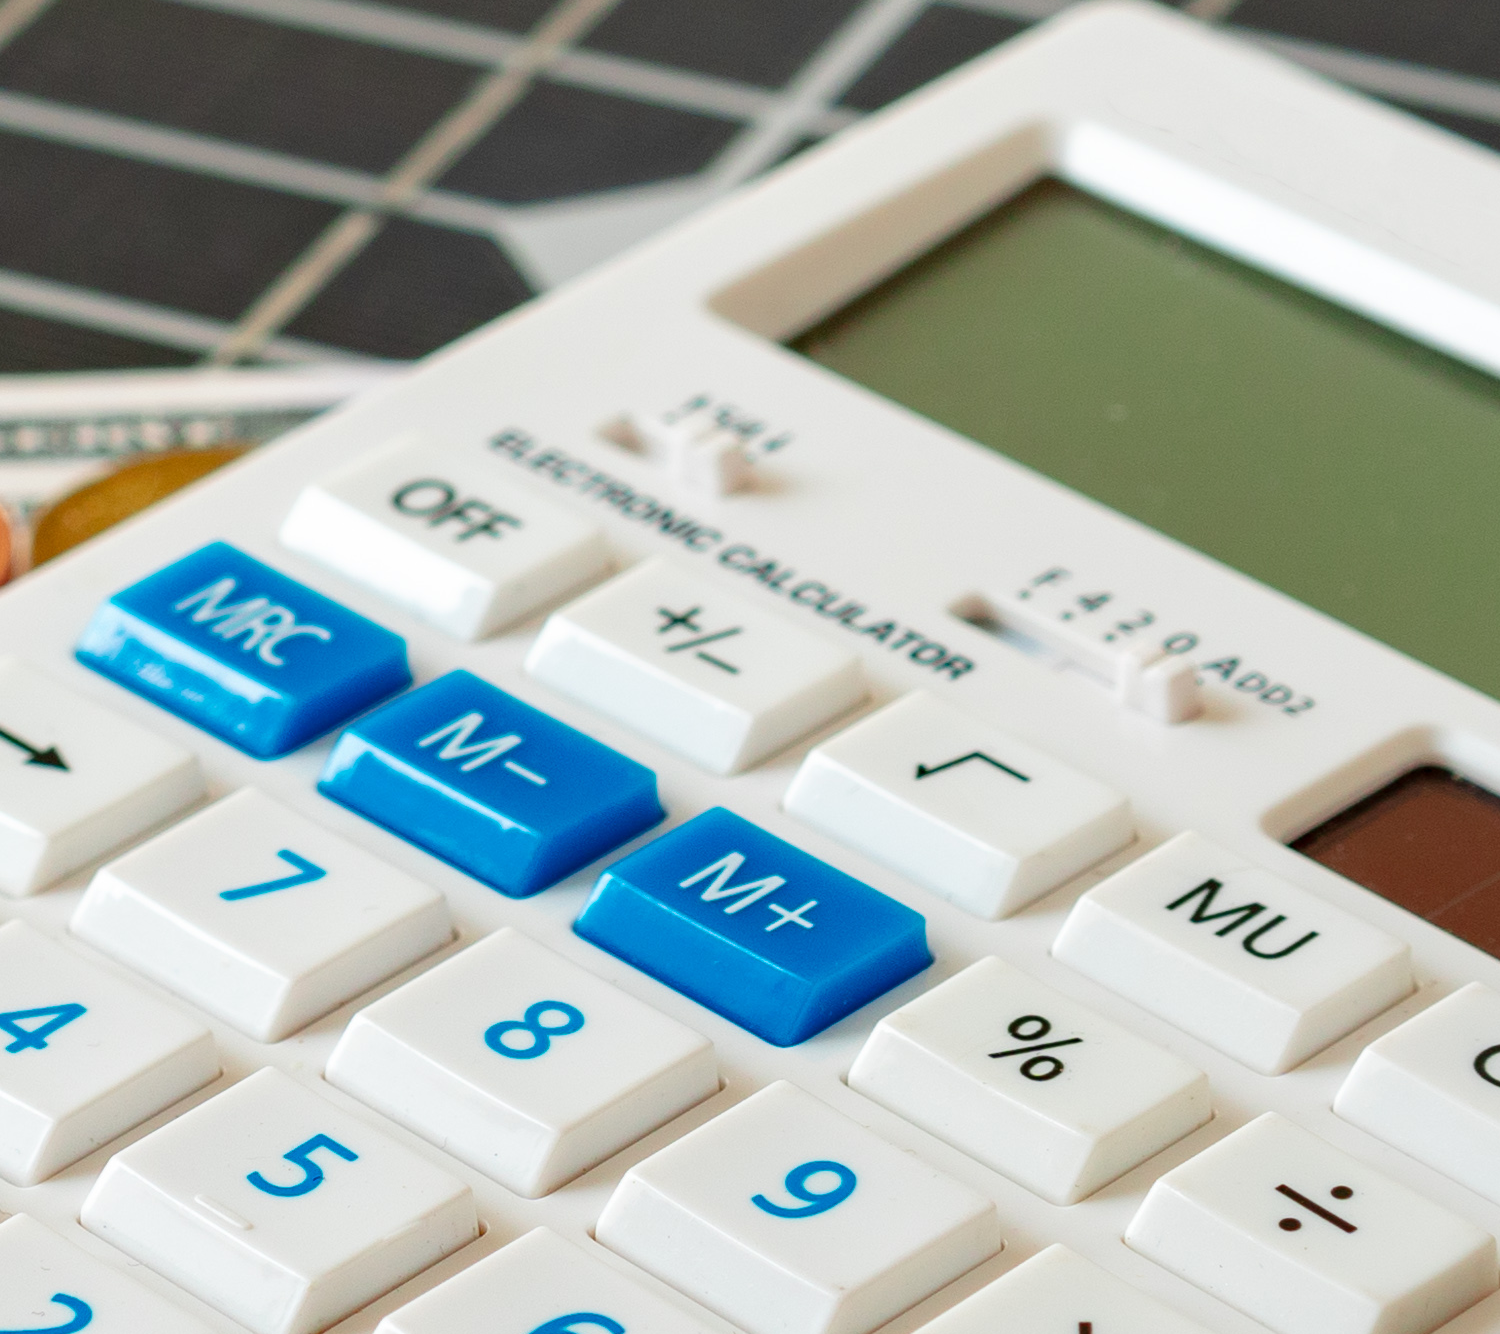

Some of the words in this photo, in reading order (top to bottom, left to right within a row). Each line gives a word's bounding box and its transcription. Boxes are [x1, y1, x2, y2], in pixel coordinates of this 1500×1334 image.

[390, 476, 522, 545] OFF
[488, 428, 722, 553] ELECTRONIC
[718, 545, 975, 680] CALCULATOR
[175, 575, 332, 667] MRC
[1116, 610, 1156, 635] 2
[1202, 655, 1316, 717] ADD2
[218, 848, 328, 902] 7
[678, 850, 819, 935] M+
[1165, 878, 1320, 960] MU
[483, 999, 586, 1061] 8
[987, 1014, 1084, 1082] %
[245, 1132, 360, 1199] 5
[750, 1159, 858, 1220] 9
